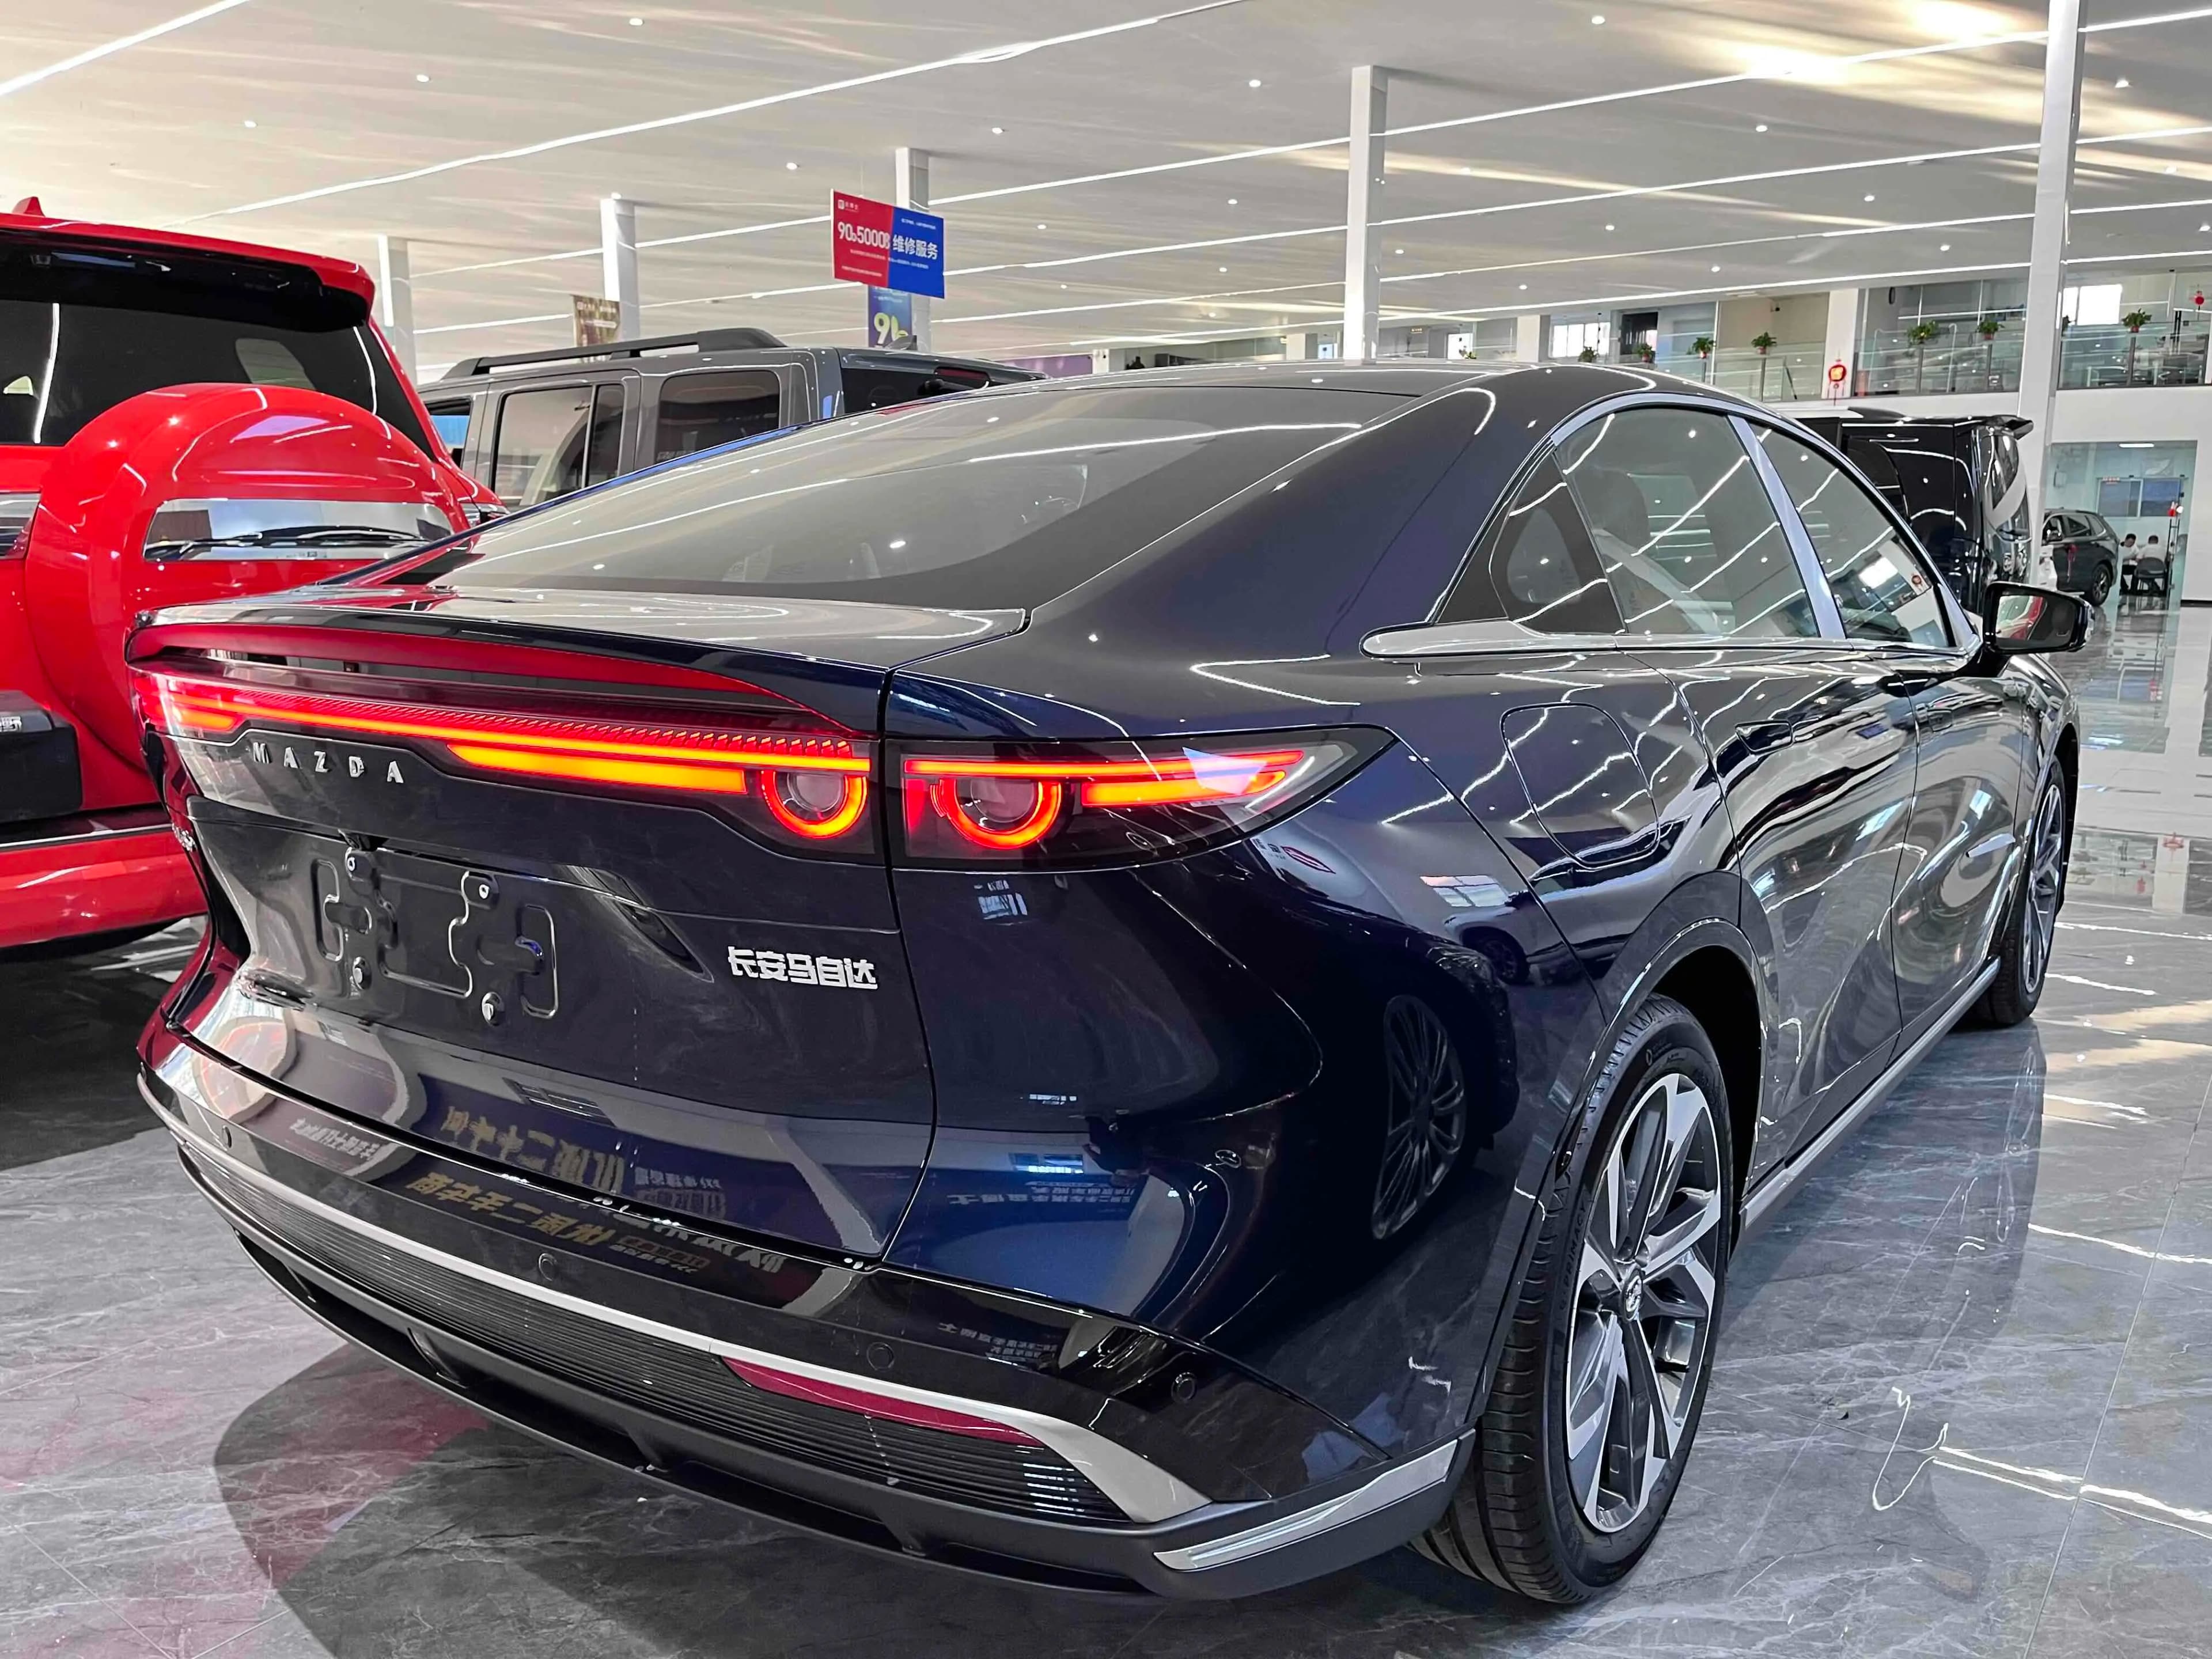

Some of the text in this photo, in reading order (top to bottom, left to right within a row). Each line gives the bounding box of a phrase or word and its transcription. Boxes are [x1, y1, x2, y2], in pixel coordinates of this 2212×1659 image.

[893, 234, 938, 260] 维修服务
[252, 742, 404, 784] MAZDA
[728, 946, 878, 990] 长安马自达
